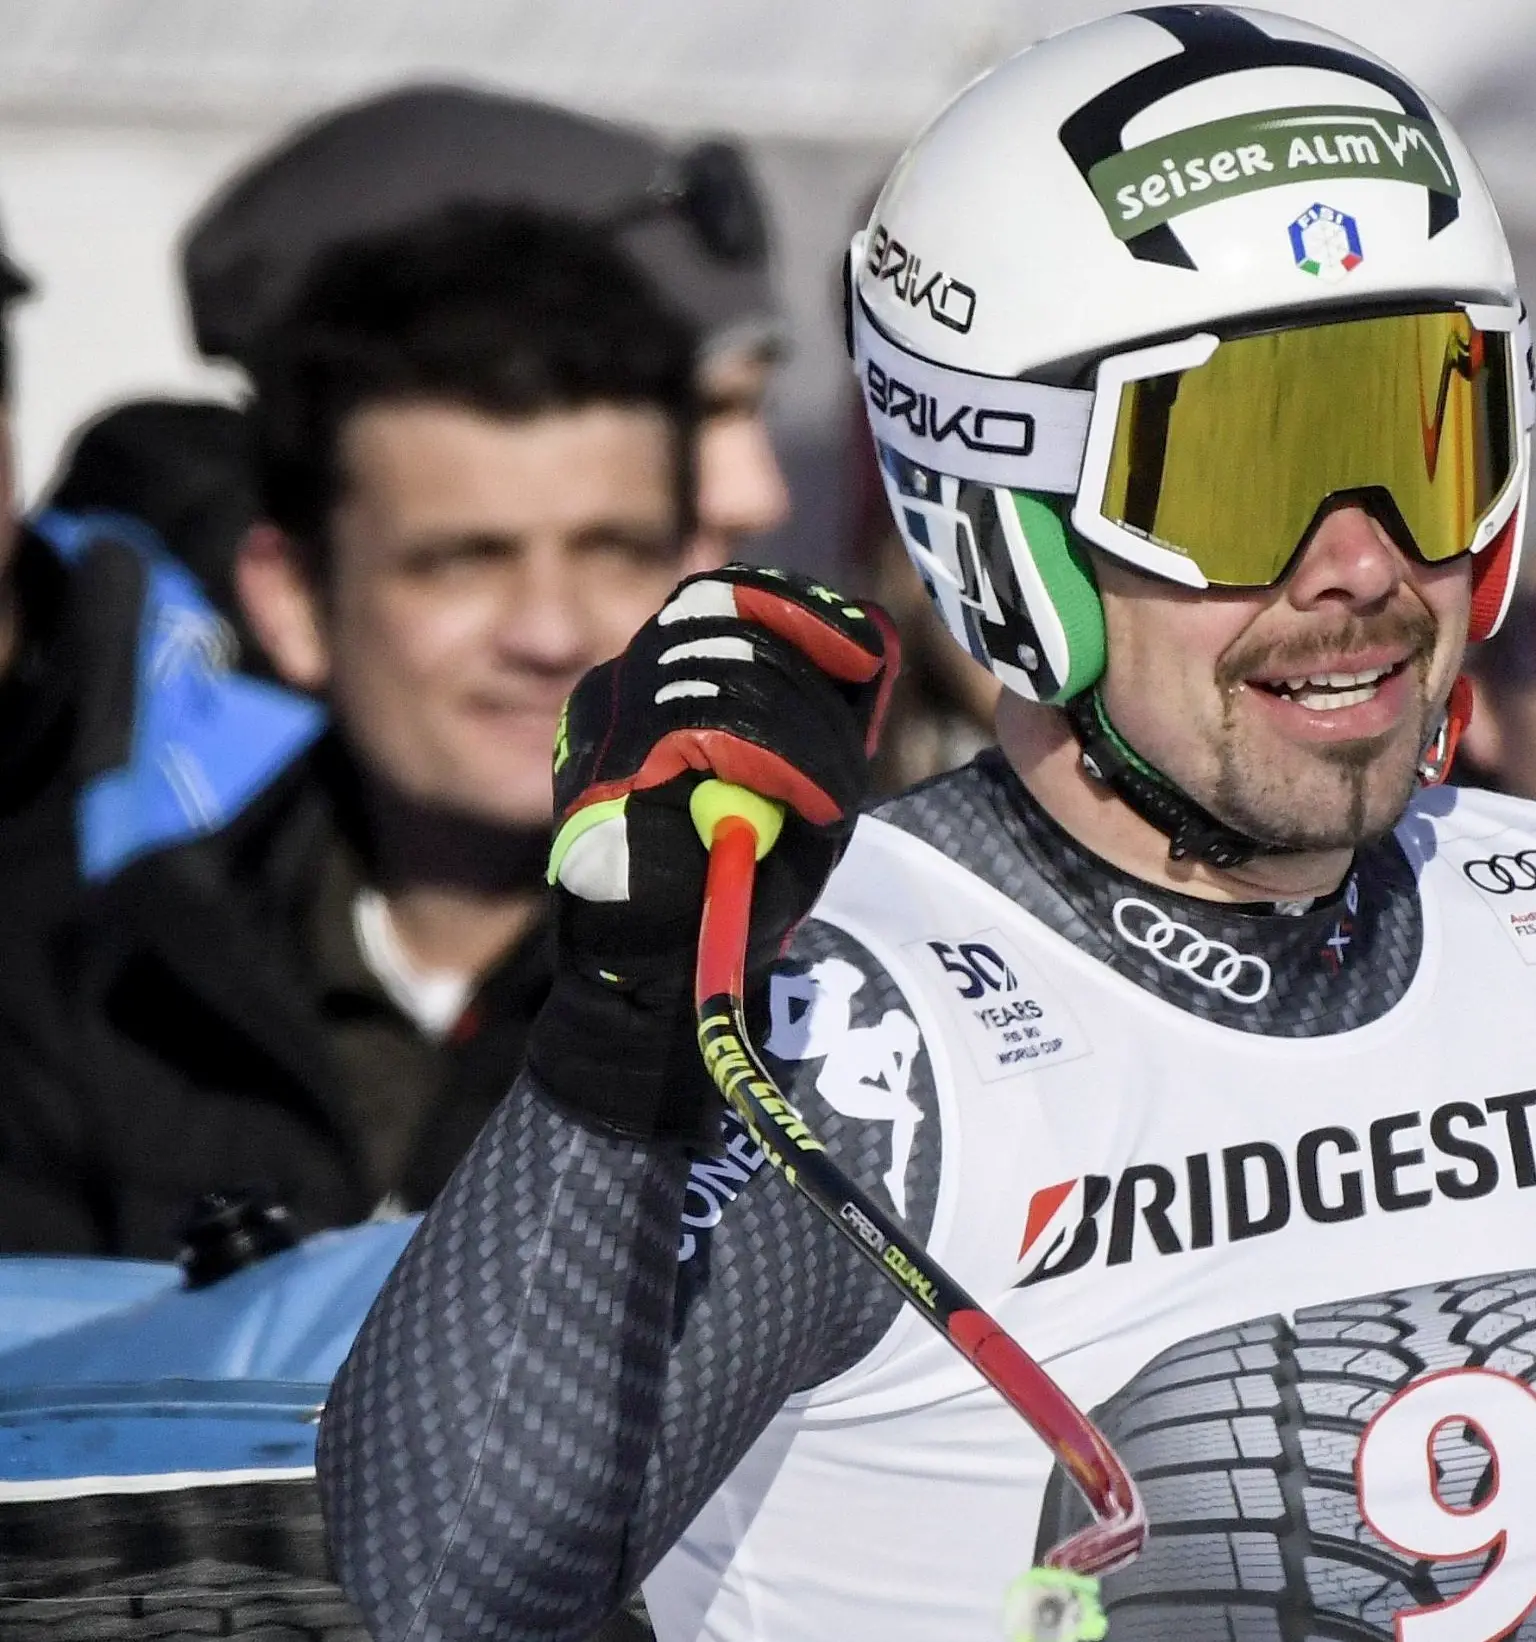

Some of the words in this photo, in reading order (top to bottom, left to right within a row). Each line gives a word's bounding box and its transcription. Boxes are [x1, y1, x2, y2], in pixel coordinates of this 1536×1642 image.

[868, 224, 977, 334] BRIKO
[867, 358, 1036, 456] BRIKO
[1514, 924, 1536, 937] FIS
[926, 940, 1018, 999] 50
[973, 1000, 1044, 1030] YEARS
[1040, 1037, 1063, 1053] CUP
